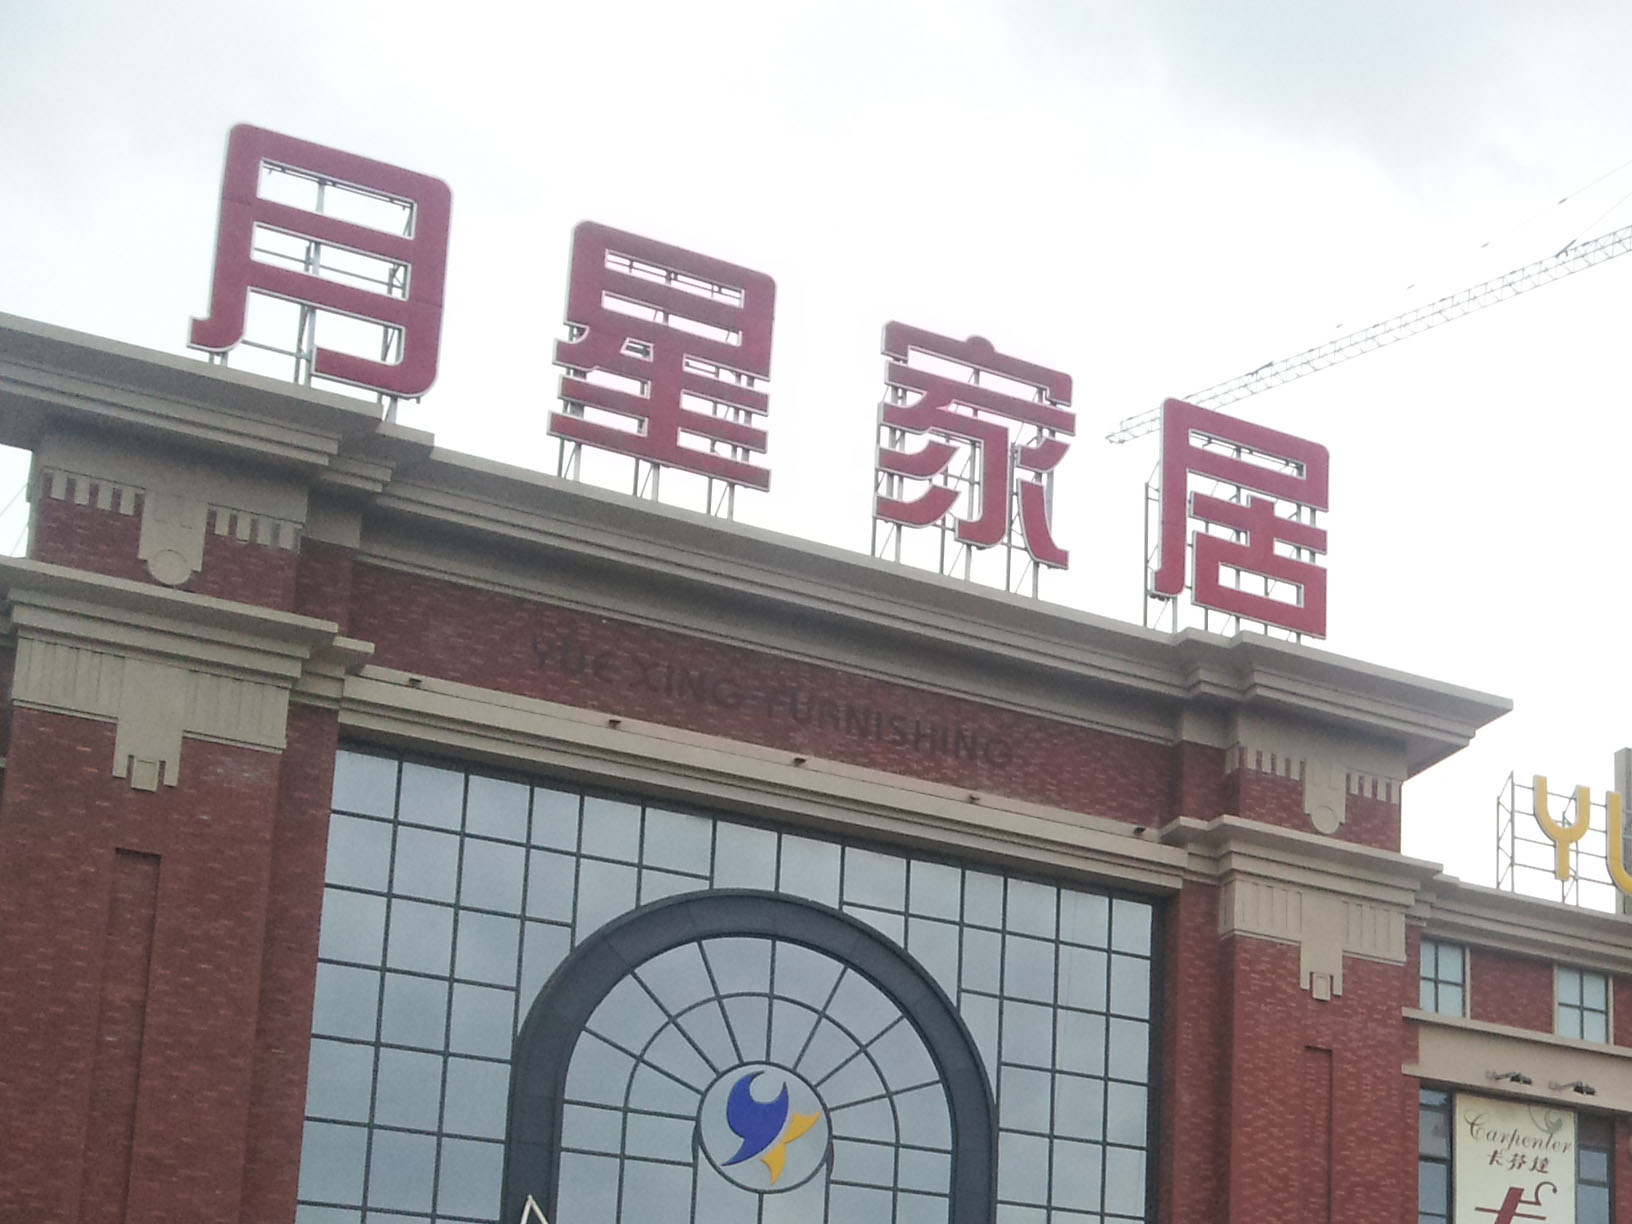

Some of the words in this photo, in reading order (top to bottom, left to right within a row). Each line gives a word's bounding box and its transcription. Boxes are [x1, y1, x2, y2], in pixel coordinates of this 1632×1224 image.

[187, 123, 1329, 639] 月星家居
[762, 686, 1013, 770] FURNISHING
[1464, 1112, 1572, 1153] Carpenter
